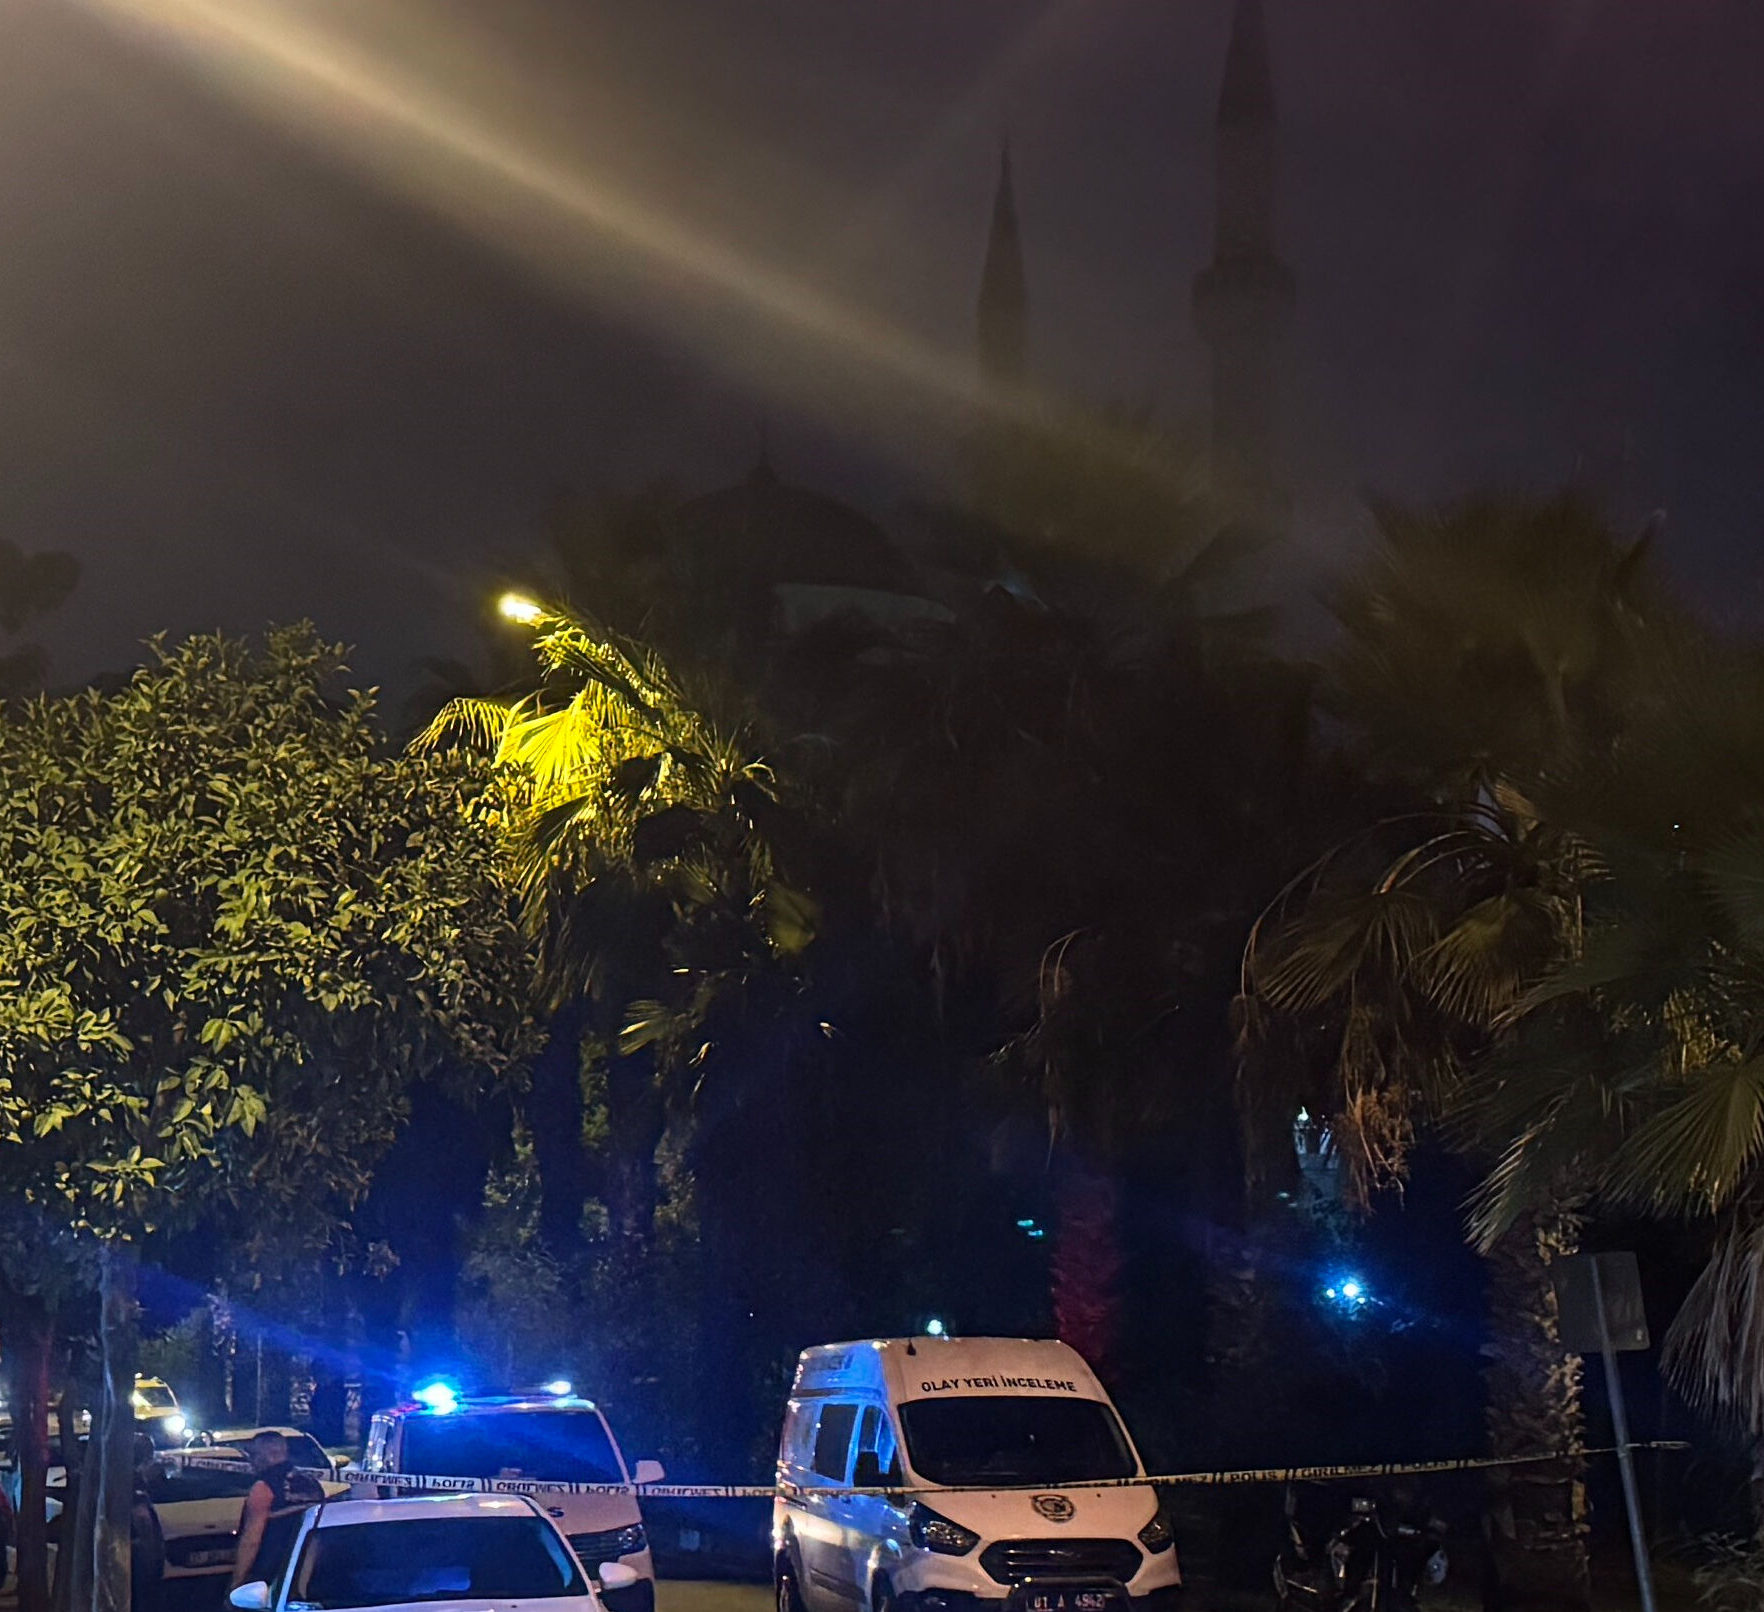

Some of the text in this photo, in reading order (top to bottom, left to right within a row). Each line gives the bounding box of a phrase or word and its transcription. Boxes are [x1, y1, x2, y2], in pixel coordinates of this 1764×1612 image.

[921, 1374, 1077, 1393] OLAY YERİ İNCELEME
